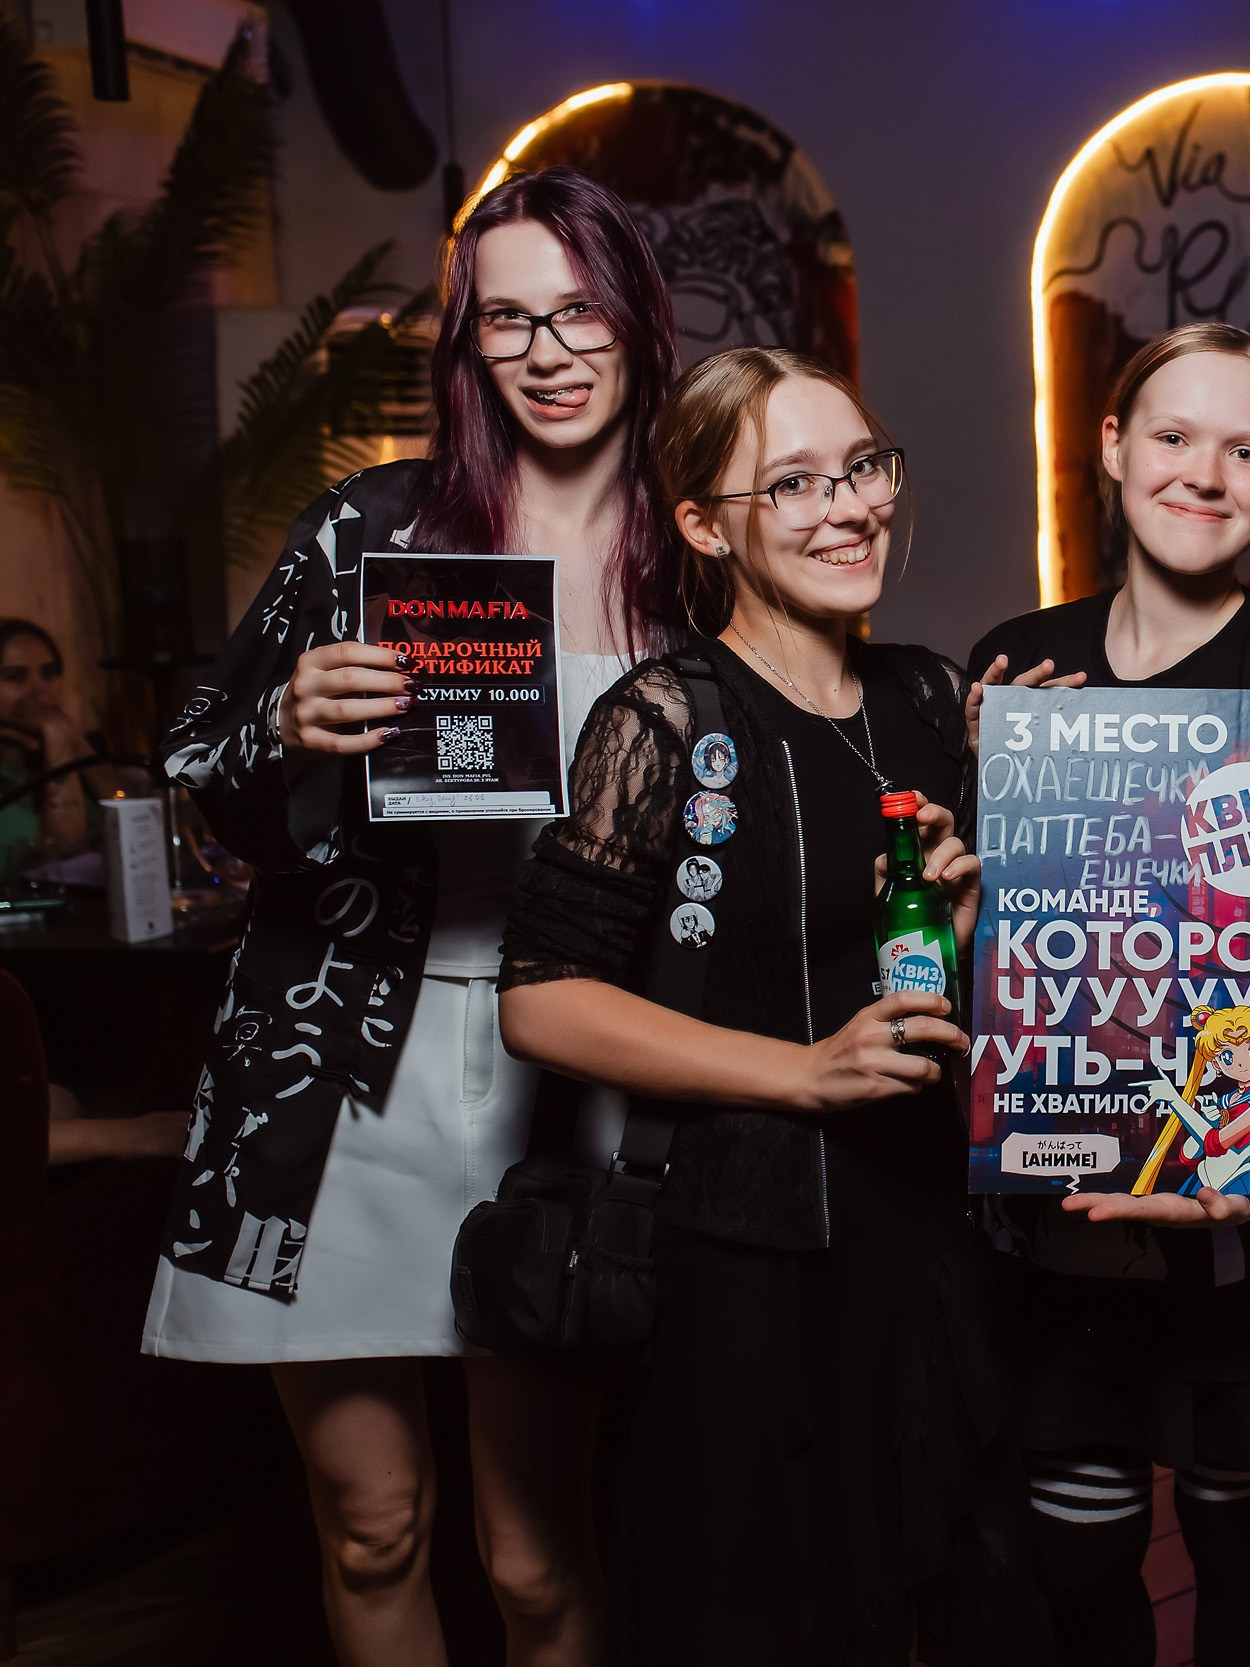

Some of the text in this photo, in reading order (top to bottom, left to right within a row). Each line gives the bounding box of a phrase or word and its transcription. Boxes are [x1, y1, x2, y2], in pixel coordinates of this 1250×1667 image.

[387, 600, 530, 619] DON MAFIA
[399, 660, 534, 675] РТИФИКАТ
[417, 688, 540, 701] СУММУ 10.000
[1004, 713, 1228, 754] 3 МЕСТО
[1079, 857, 1203, 891] ЕШЕЧКИ
[998, 888, 1158, 918] КОМАНДЕ,
[994, 1093, 1025, 1113] НЕ
[1030, 1094, 1151, 1114] ХВАТИЛО
[1037, 1139, 1082, 1151] がんばって
[1022, 1151, 1097, 1169] [АНИМЕ]
